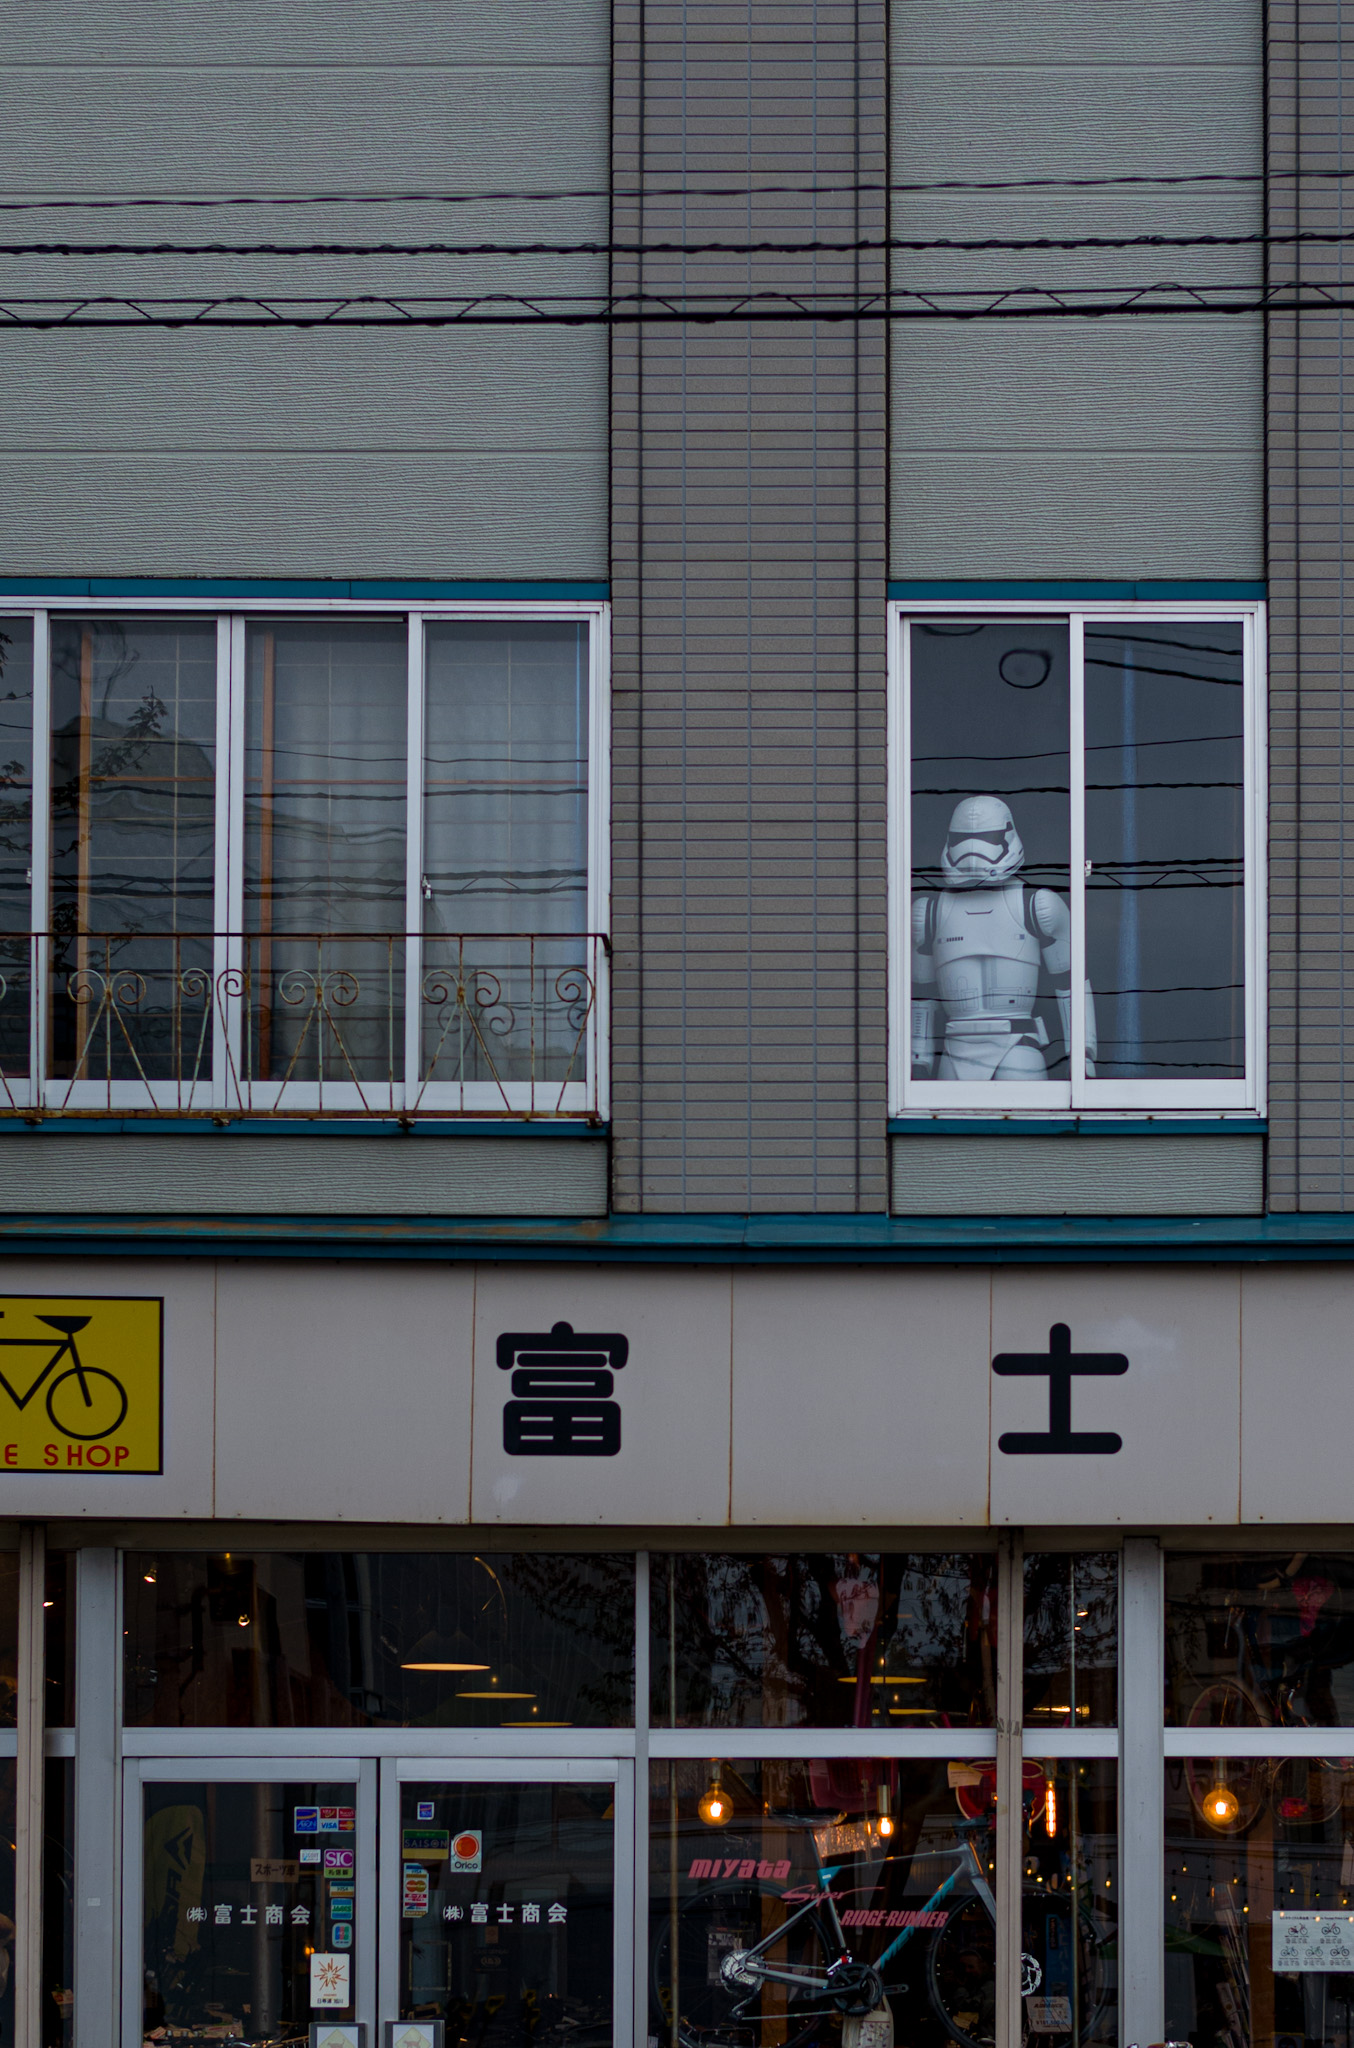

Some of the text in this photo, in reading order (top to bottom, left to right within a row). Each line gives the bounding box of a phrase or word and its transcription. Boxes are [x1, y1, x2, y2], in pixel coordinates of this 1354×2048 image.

[496, 1321, 1130, 1456] 富 士
[43, 1444, 129, 1467] SHOP
[404, 1839, 448, 1847] SAISON
[325, 1852, 353, 1866] SIC
[454, 1861, 479, 1870] Orico
[780, 1883, 886, 1907] Super
